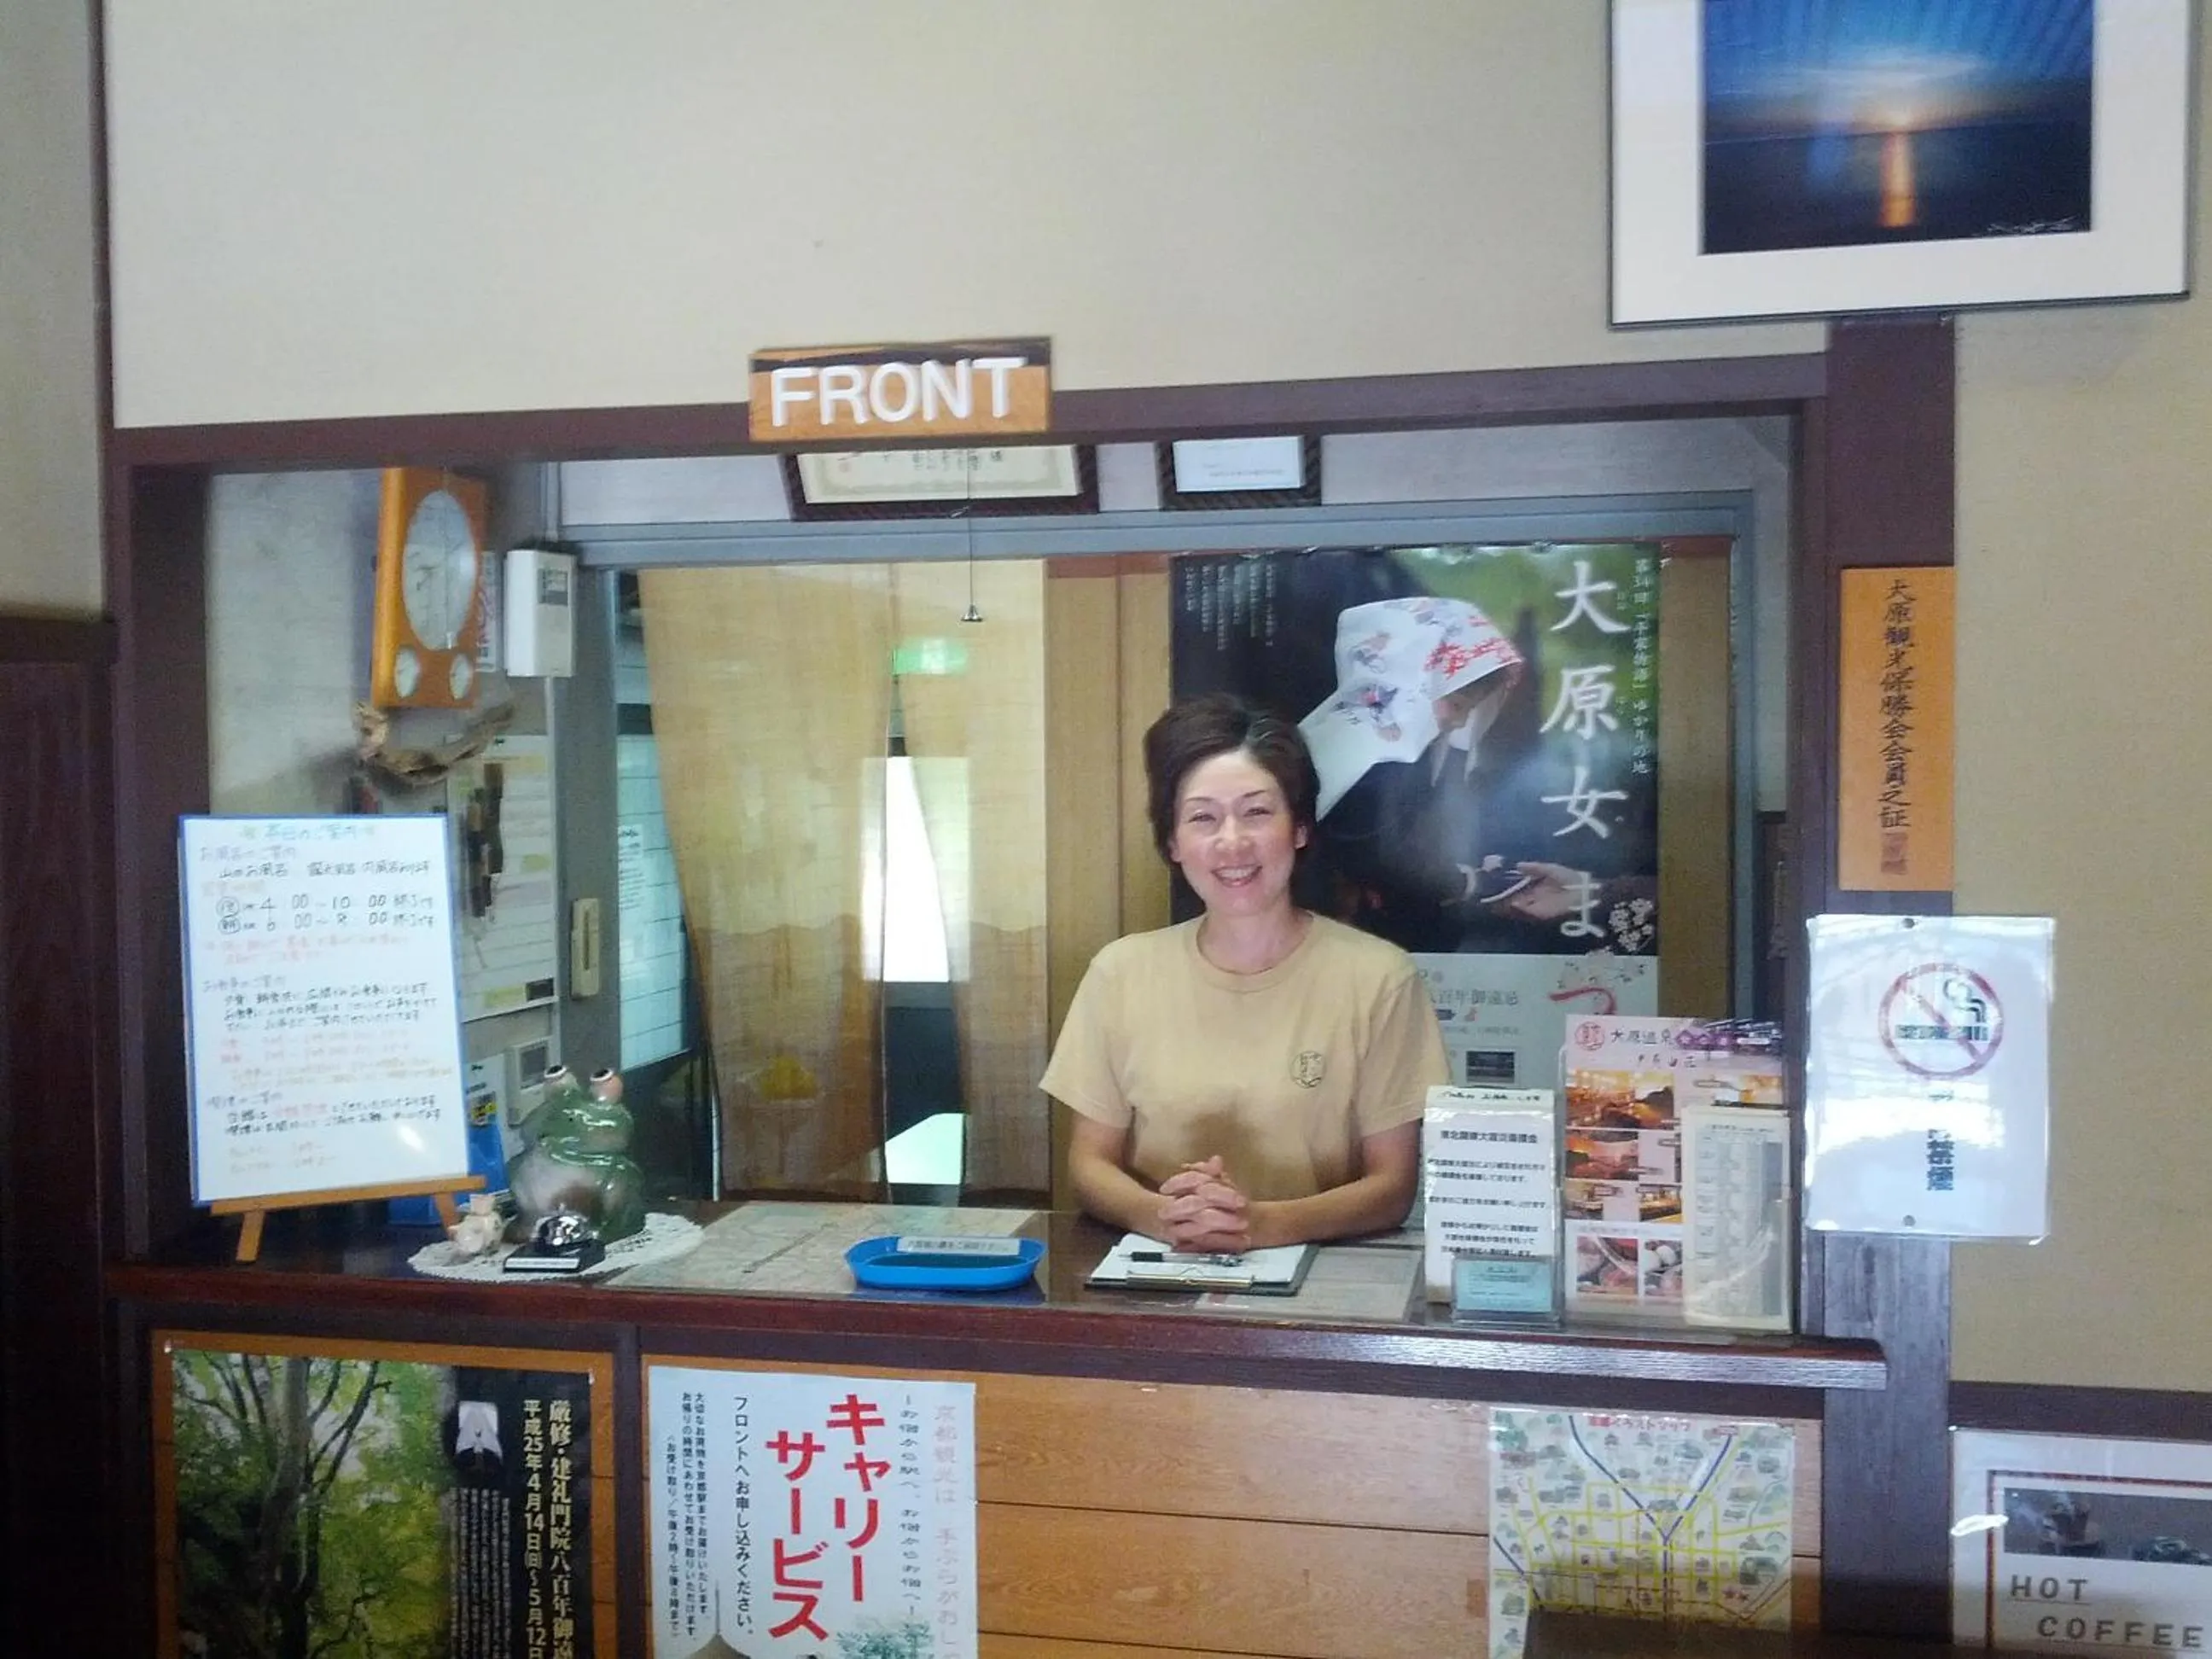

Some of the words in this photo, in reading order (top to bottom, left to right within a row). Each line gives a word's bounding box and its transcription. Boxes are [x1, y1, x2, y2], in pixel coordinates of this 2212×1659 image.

[770, 357, 1028, 427] FRONT
[734, 1396, 753, 1635] フロントへお申し込みください。
[765, 1430, 829, 1642] サービス
[826, 1394, 891, 1602] キャリー
[2010, 1575, 2088, 1600] HOT
[2036, 1615, 2204, 1648] COFFEE
